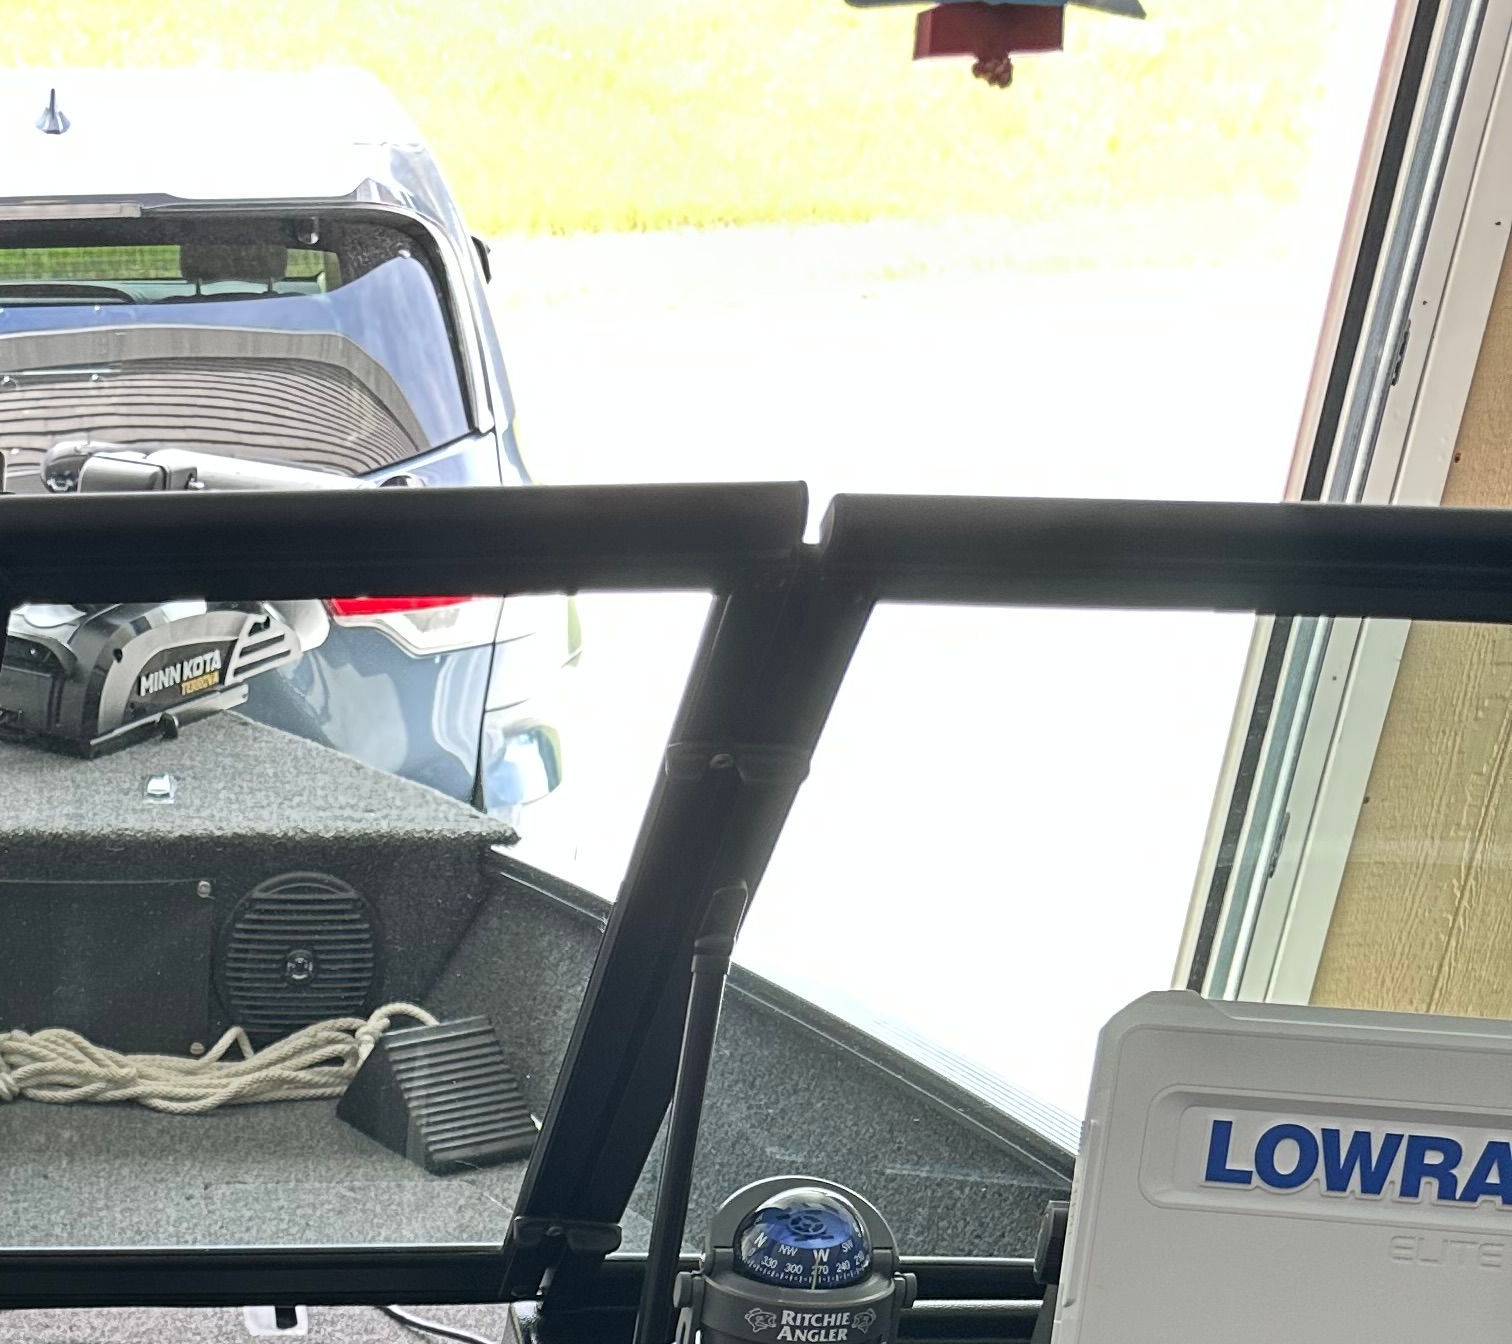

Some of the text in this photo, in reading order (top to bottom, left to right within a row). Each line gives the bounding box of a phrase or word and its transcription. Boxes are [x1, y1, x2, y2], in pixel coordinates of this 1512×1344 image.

[140, 649, 222, 697] MINN KOTA
[753, 1232, 768, 1248] N
[778, 1243, 799, 1257] NW
[813, 1248, 831, 1263] W
[761, 1255, 779, 1269] 330
[784, 1262, 804, 1275] 300
[811, 1265, 829, 1276] 270
[836, 1259, 851, 1273] 240
[780, 1309, 852, 1327] RITCHIE
[776, 1325, 849, 1343] ANGLER
